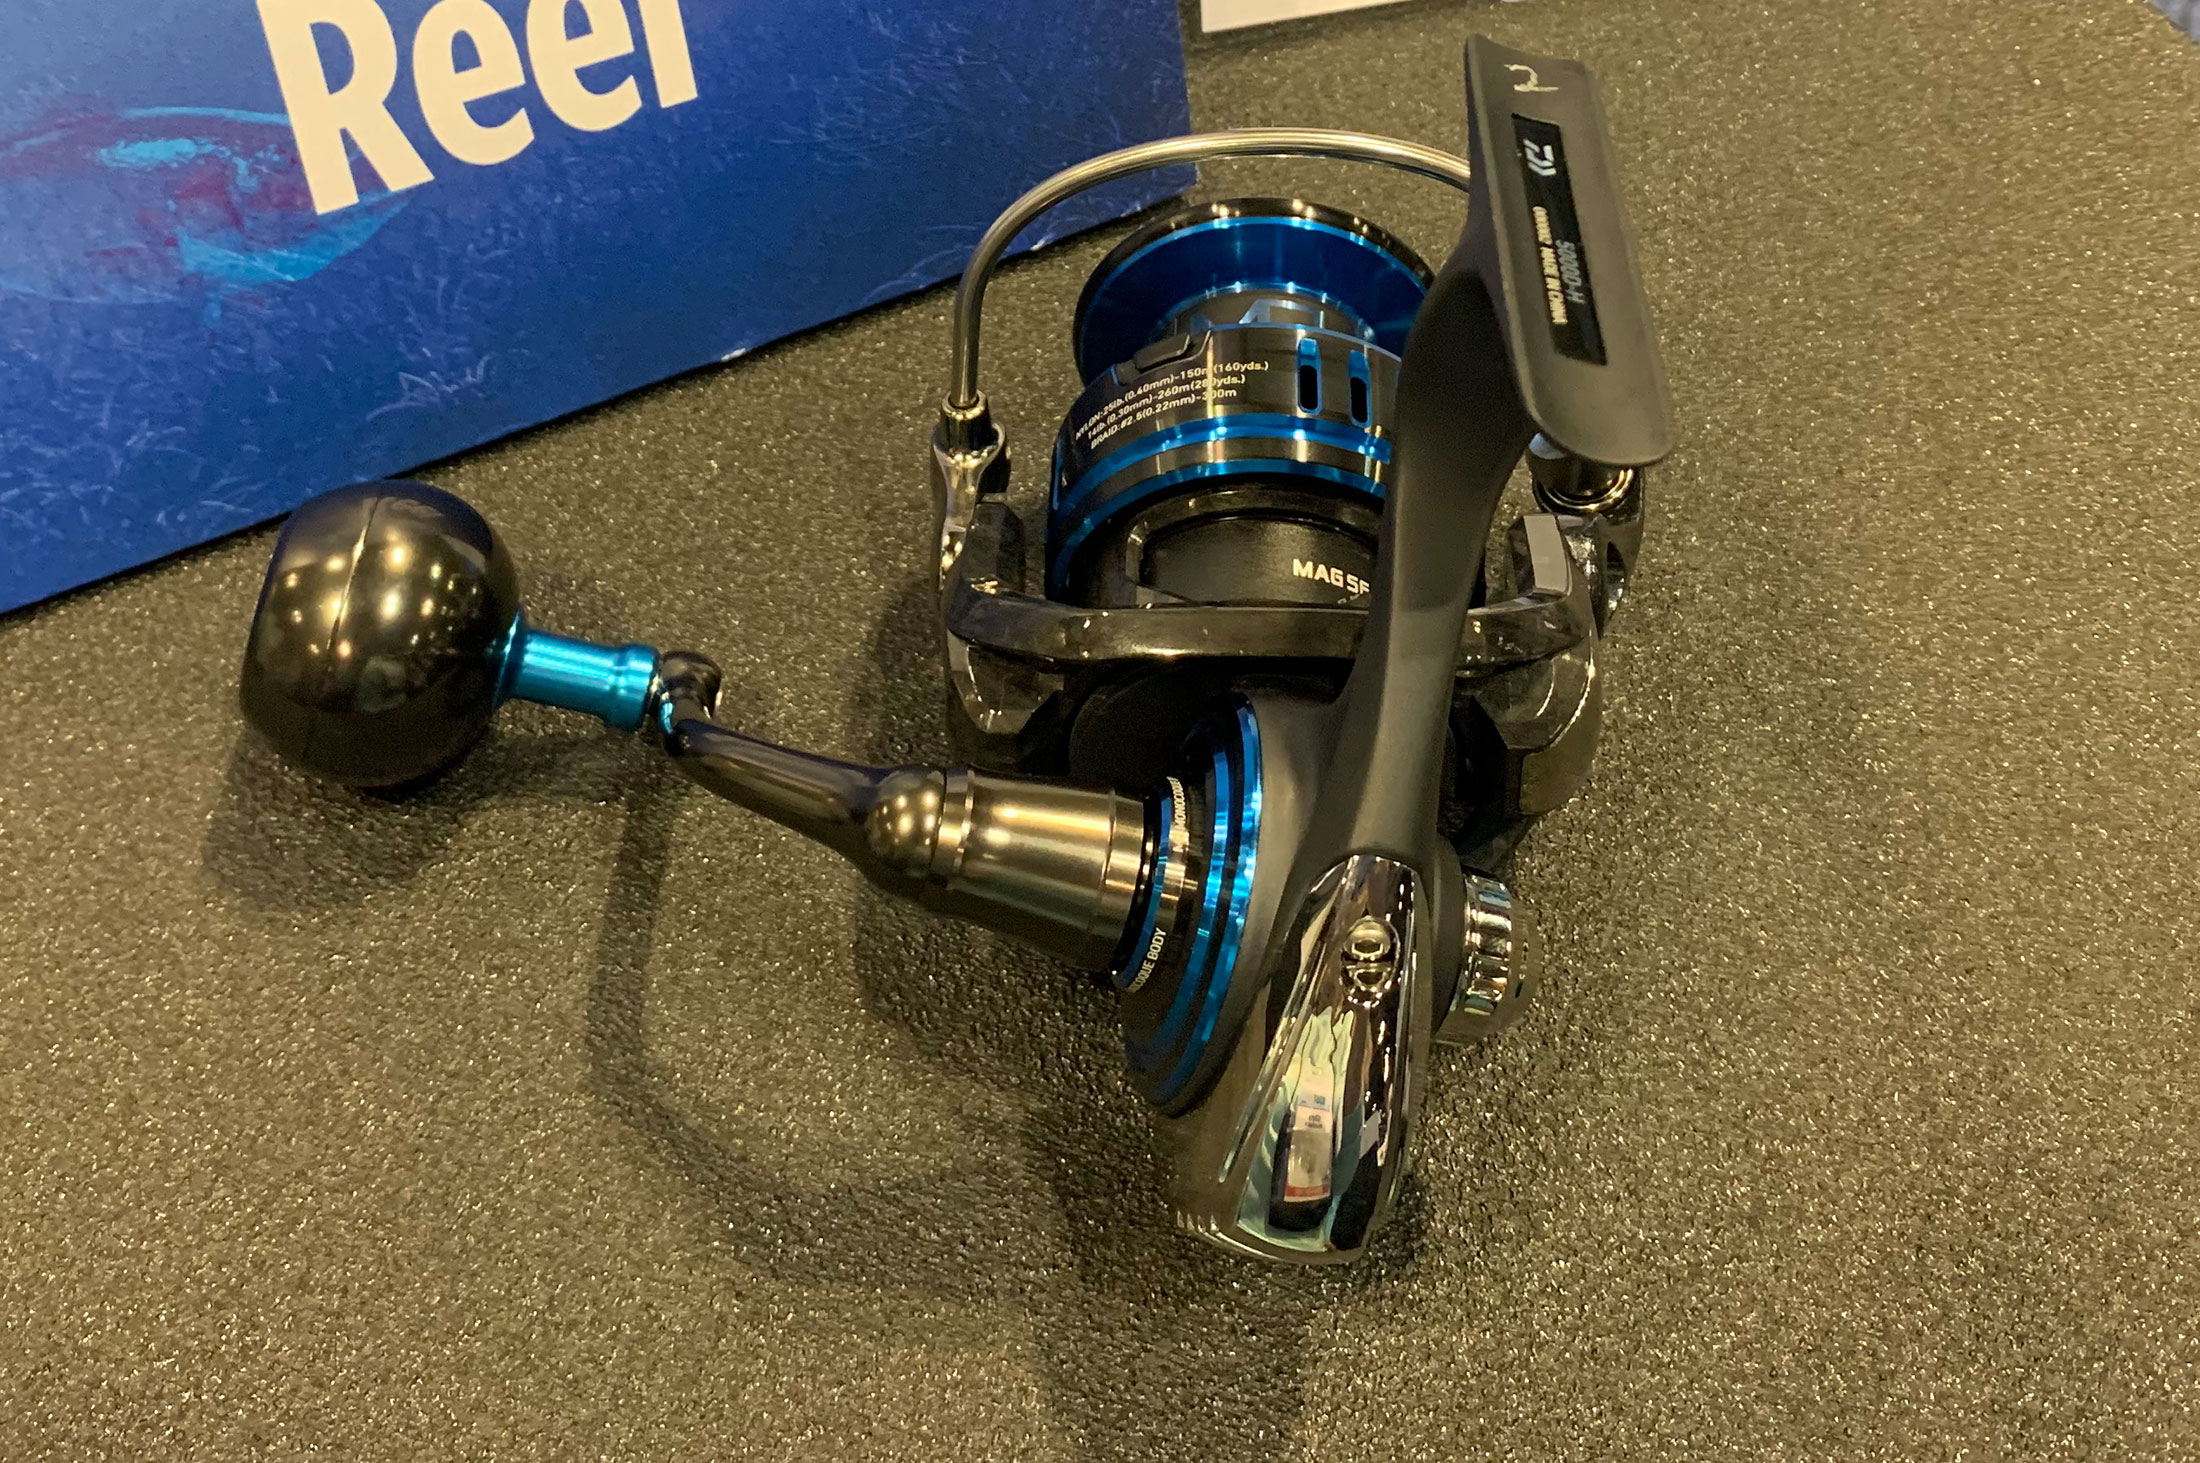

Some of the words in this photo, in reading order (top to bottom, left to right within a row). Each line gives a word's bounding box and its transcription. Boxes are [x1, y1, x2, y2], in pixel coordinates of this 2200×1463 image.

[257, 0, 698, 216] Reel
[1540, 246, 1560, 277] MADE
[1545, 277, 1561, 290] IN
[1548, 290, 1568, 325] CHINA
[1146, 927, 1167, 961] BODY
